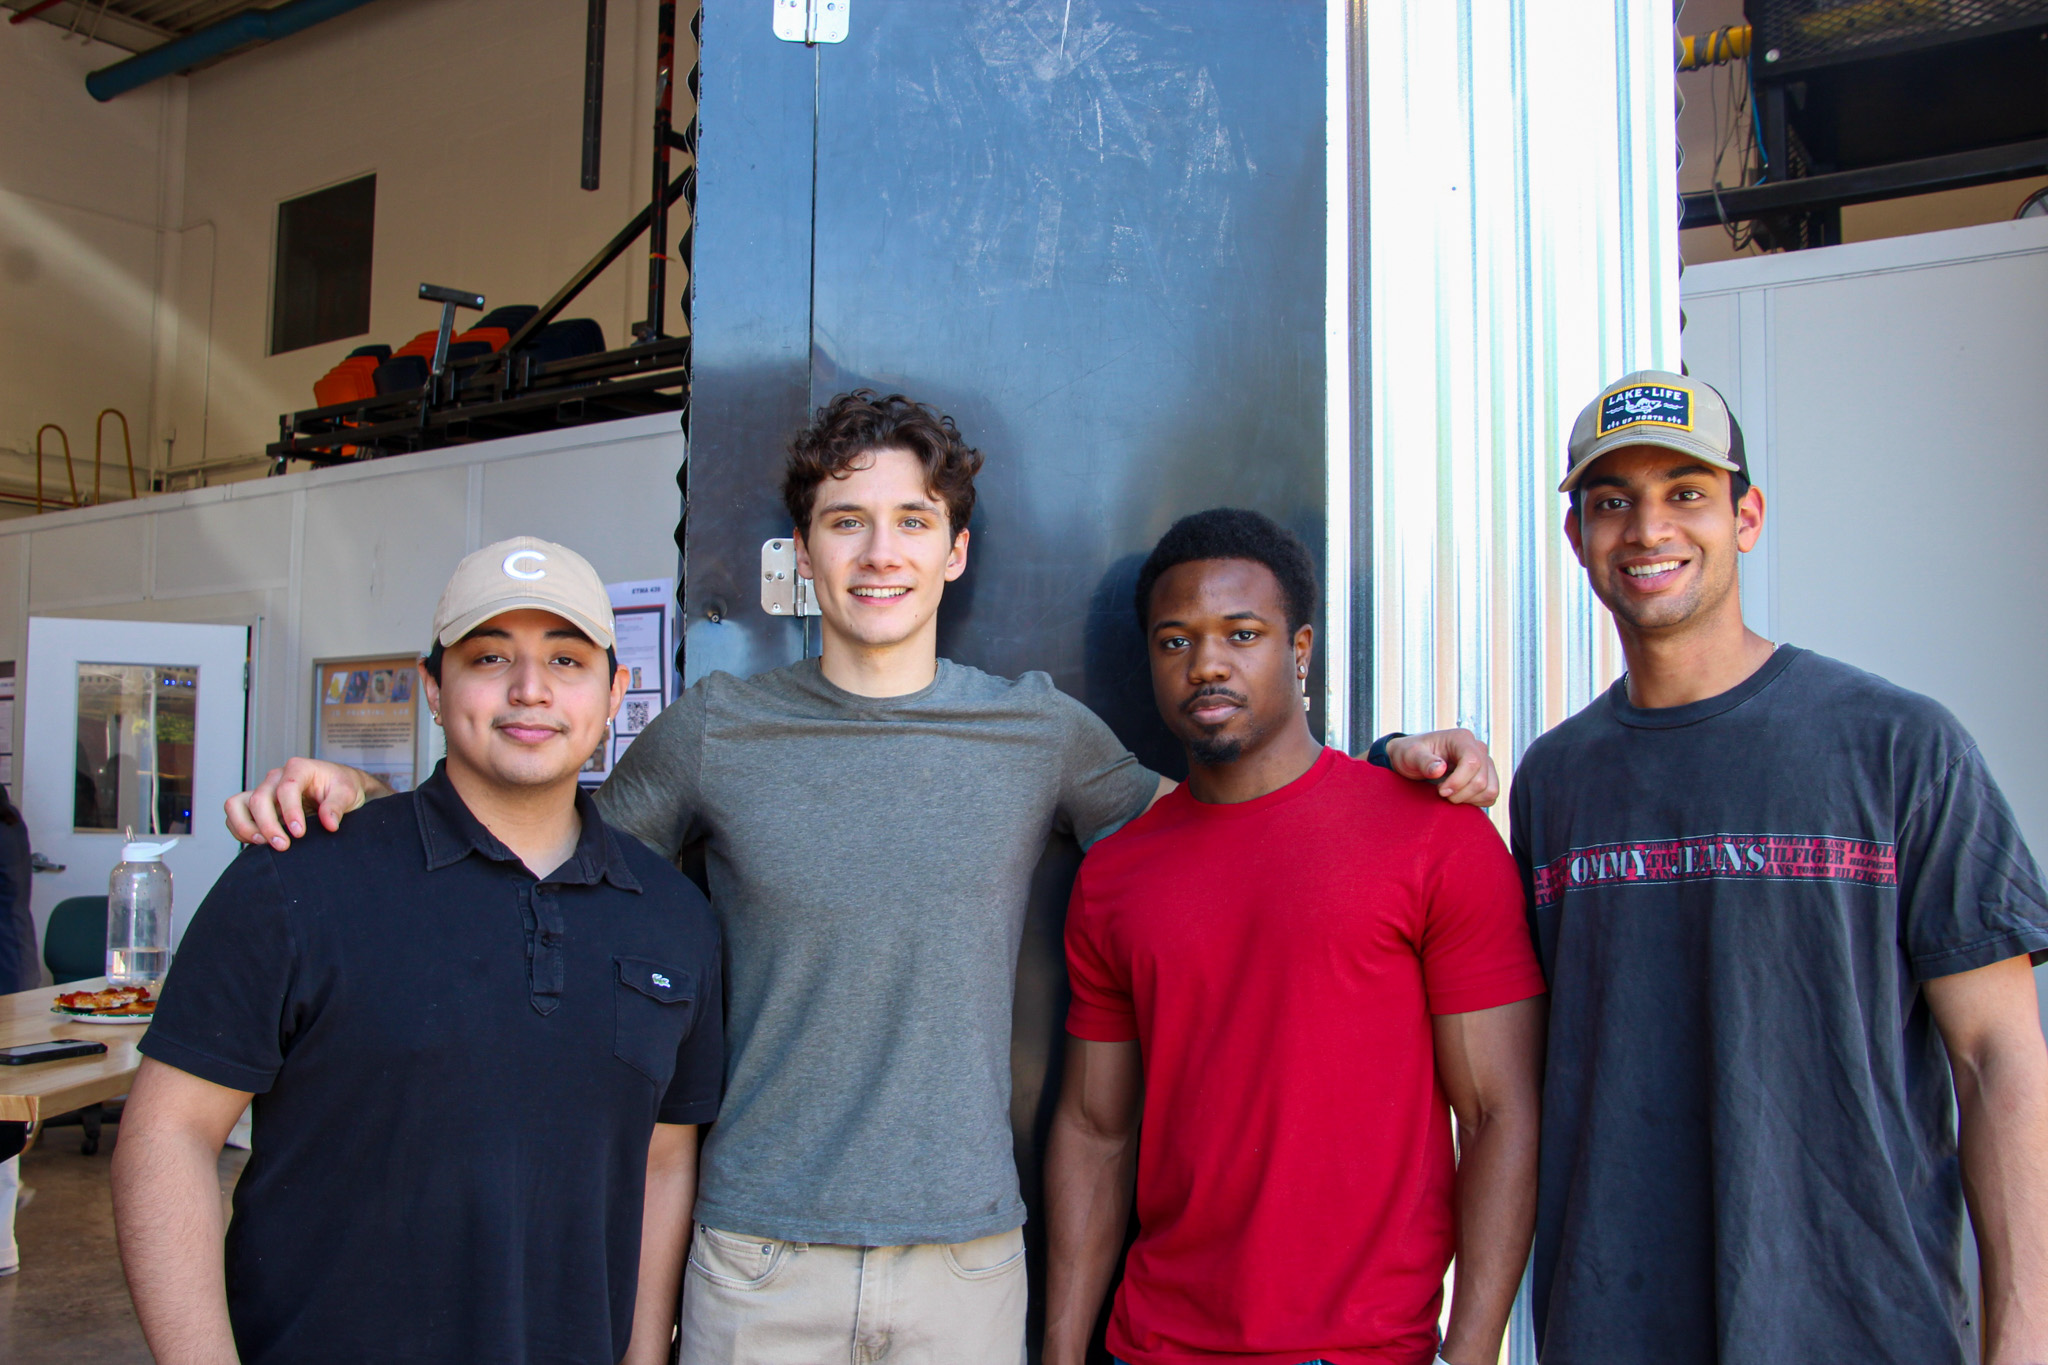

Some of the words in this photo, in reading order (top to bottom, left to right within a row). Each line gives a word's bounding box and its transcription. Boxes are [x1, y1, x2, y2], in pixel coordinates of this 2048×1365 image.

[1608, 388, 1643, 406] LAKE
[1651, 387, 1682, 401] LIFE
[1622, 416, 1633, 425] UP
[1635, 414, 1664, 422] NORTH
[502, 549, 547, 581] C
[1568, 849, 1651, 883] OMMY
[1671, 843, 1766, 875] JEANS
